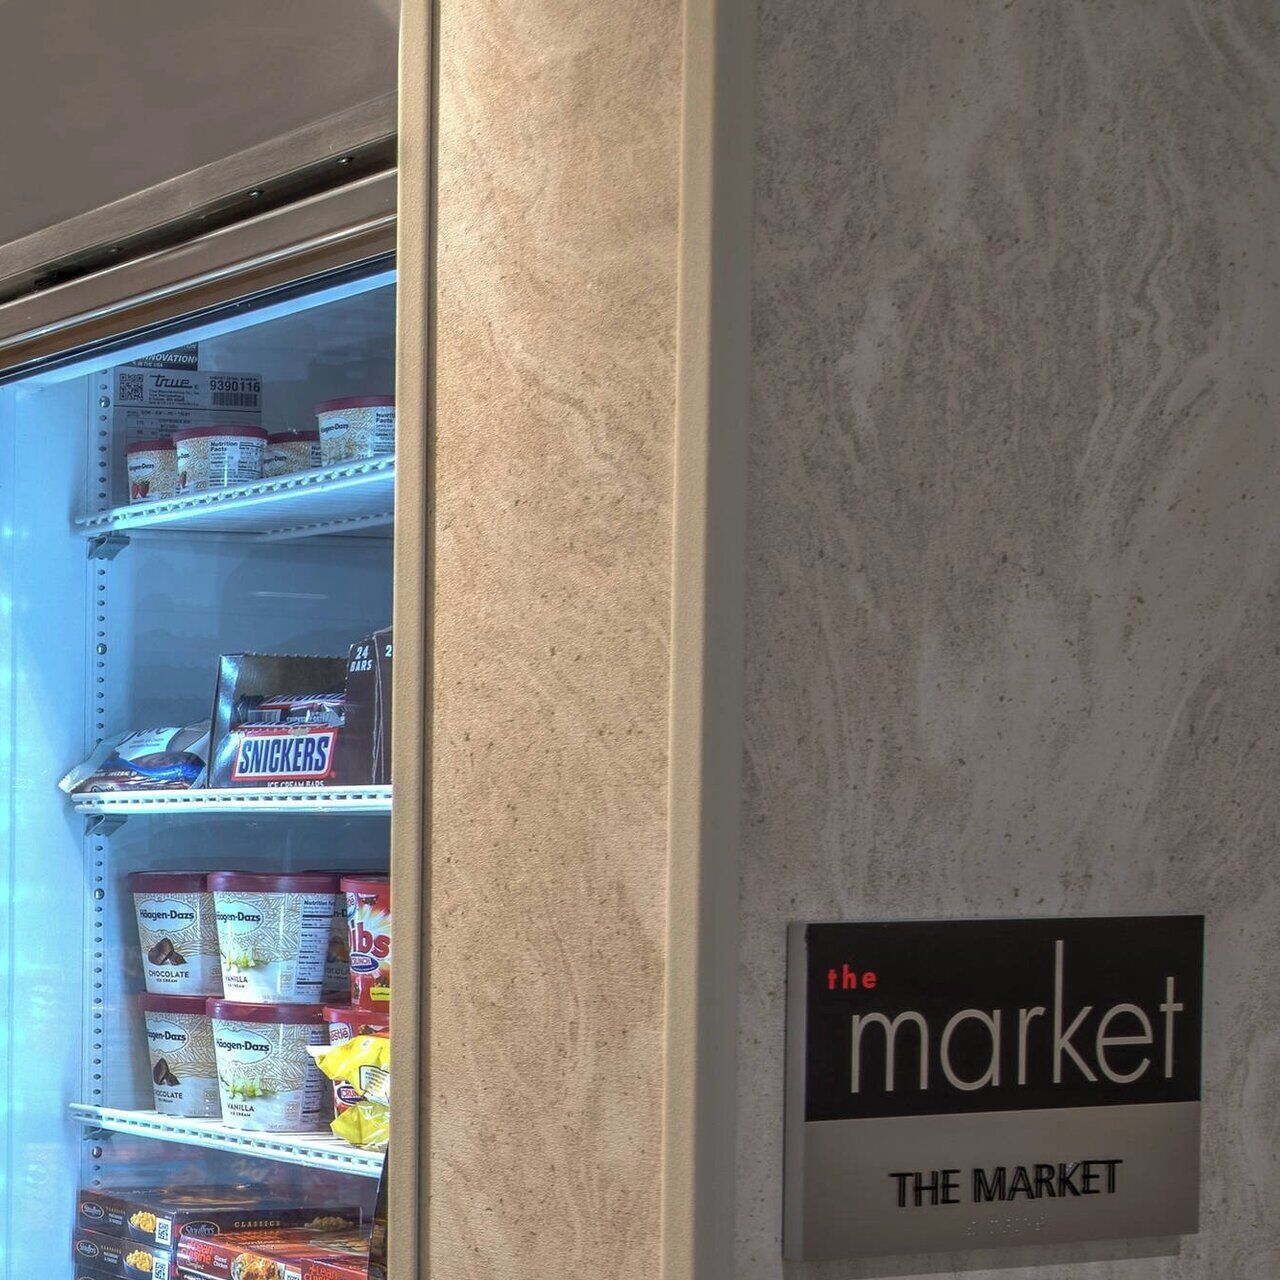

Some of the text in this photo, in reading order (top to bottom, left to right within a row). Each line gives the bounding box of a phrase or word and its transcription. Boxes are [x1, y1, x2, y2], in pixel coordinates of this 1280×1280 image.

[209, 380, 260, 392] 9390116
[355, 646, 369, 660] 24
[350, 659, 372, 672] BARS
[240, 736, 329, 774] SNICKERS
[149, 970, 190, 978] CHOCOLATE
[826, 963, 879, 990] the
[850, 939, 1184, 1094] market
[888, 1158, 1123, 1207] THE MARKET
